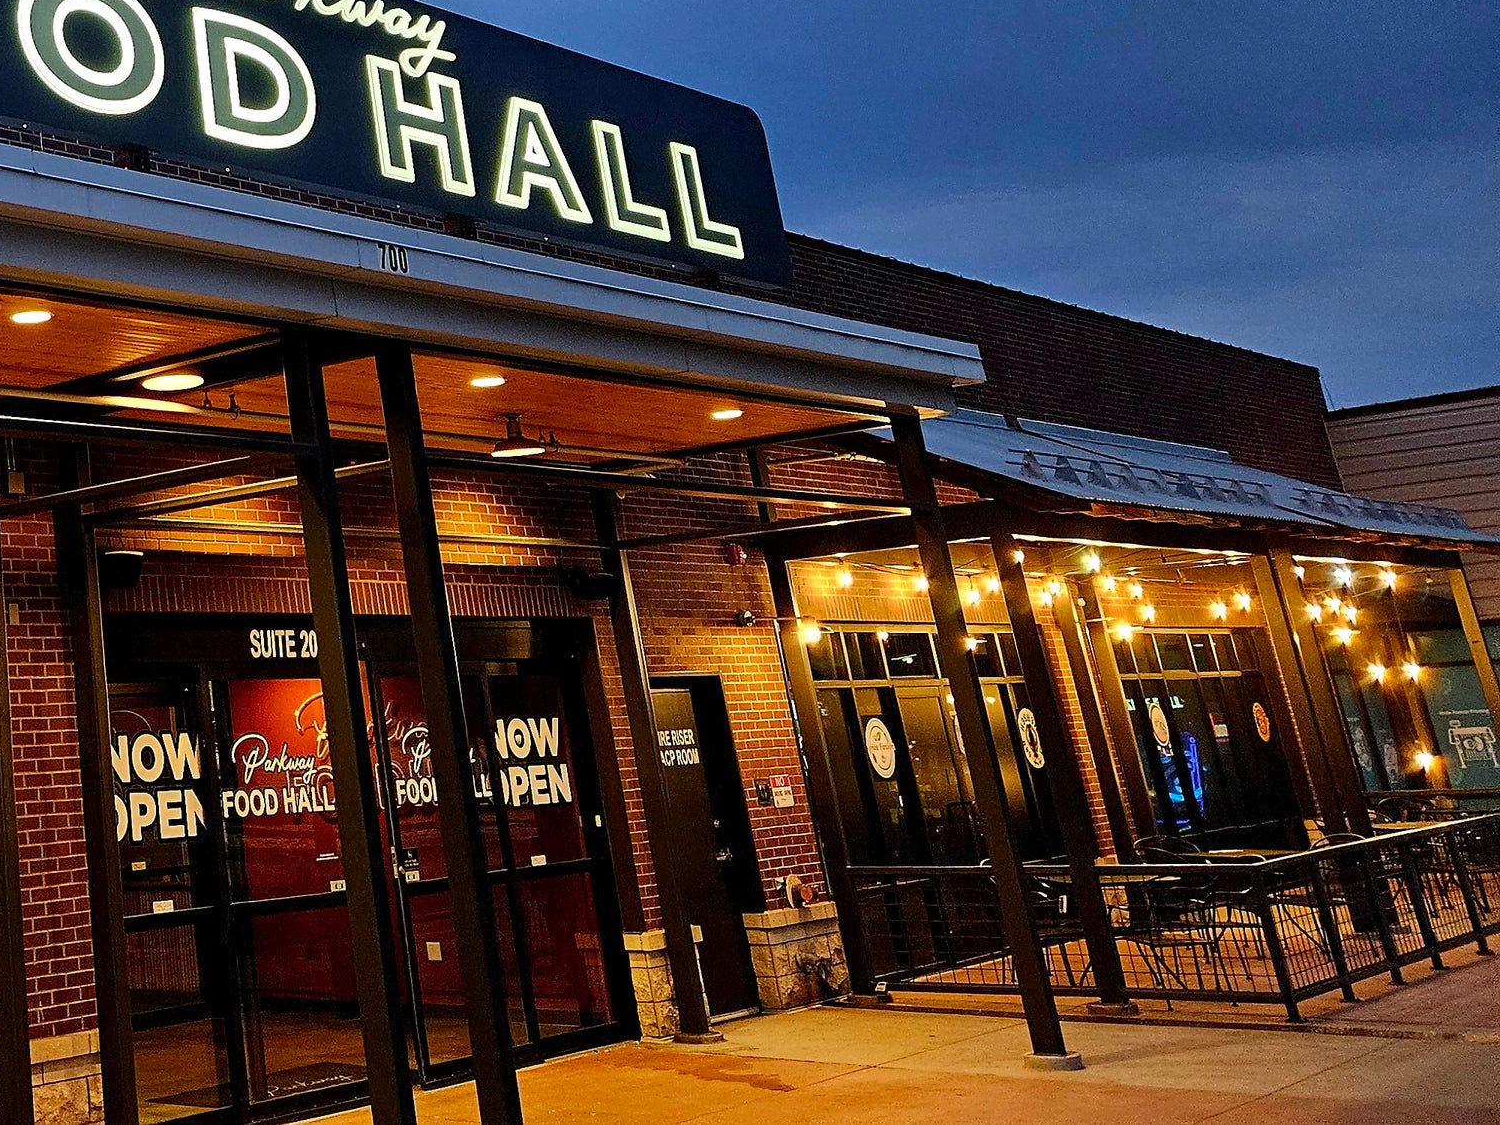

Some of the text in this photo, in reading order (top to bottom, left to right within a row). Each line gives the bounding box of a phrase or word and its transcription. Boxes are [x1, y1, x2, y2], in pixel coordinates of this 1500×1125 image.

[365, 54, 746, 260] HALL
[376, 242, 410, 274] 700
[250, 629, 297, 658] SUITE
[657, 729, 696, 746] IRE RISER
[232, 733, 317, 784] Parkway
[660, 748, 700, 766] ACP ROOM
[222, 785, 336, 819] FOOD HALL
